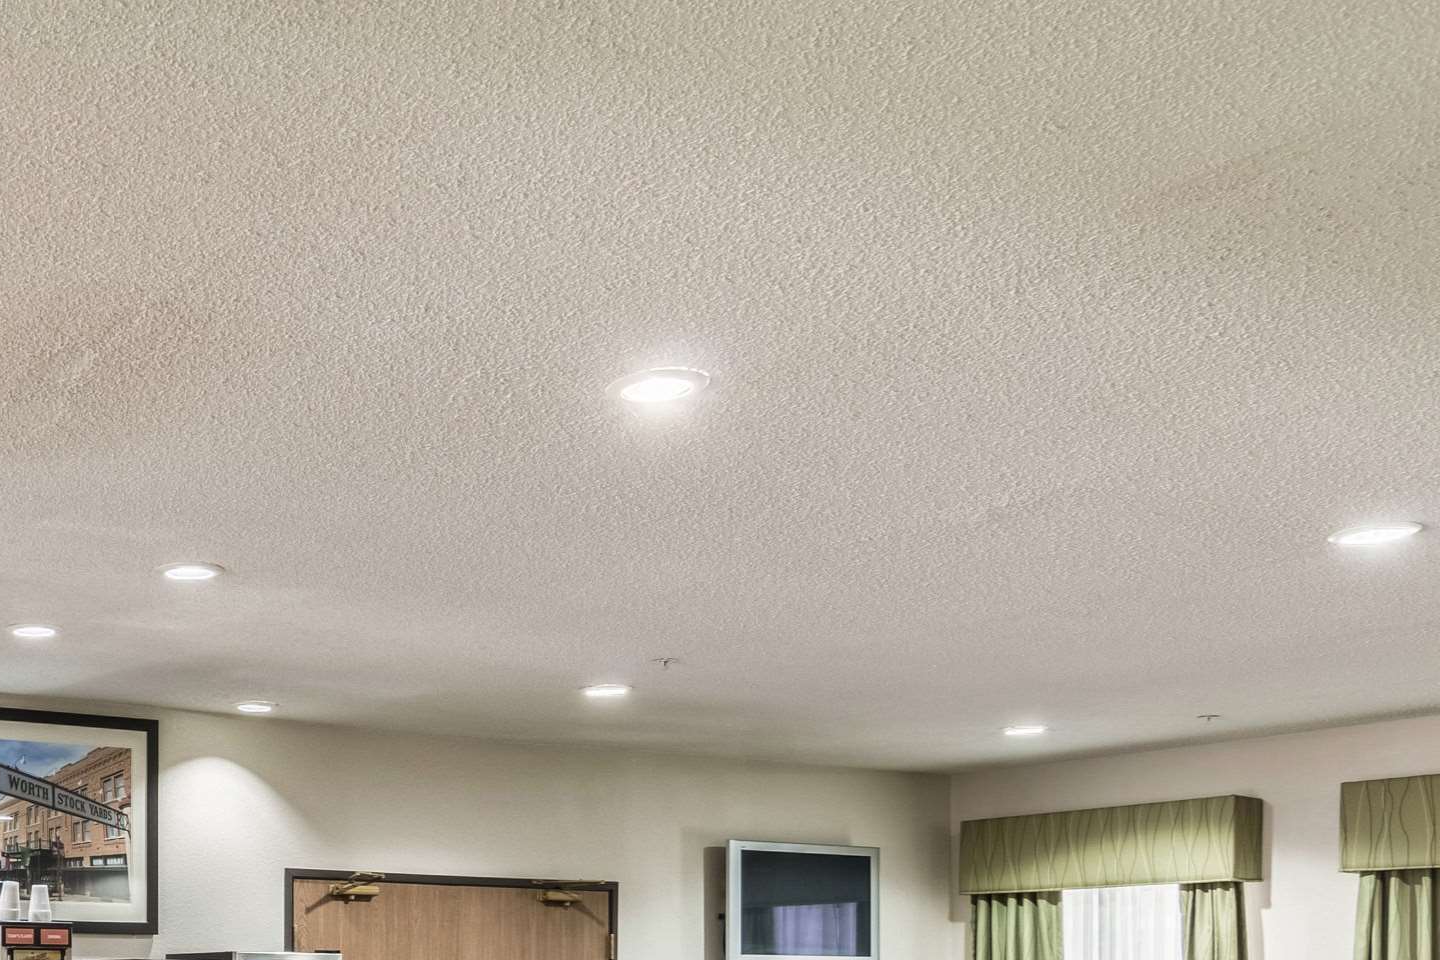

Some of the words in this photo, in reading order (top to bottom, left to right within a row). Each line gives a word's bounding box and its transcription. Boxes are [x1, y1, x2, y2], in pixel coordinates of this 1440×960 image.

[8, 774, 49, 801] WORTH
[57, 793, 87, 815] STOCK
[89, 804, 113, 821] YARDS
